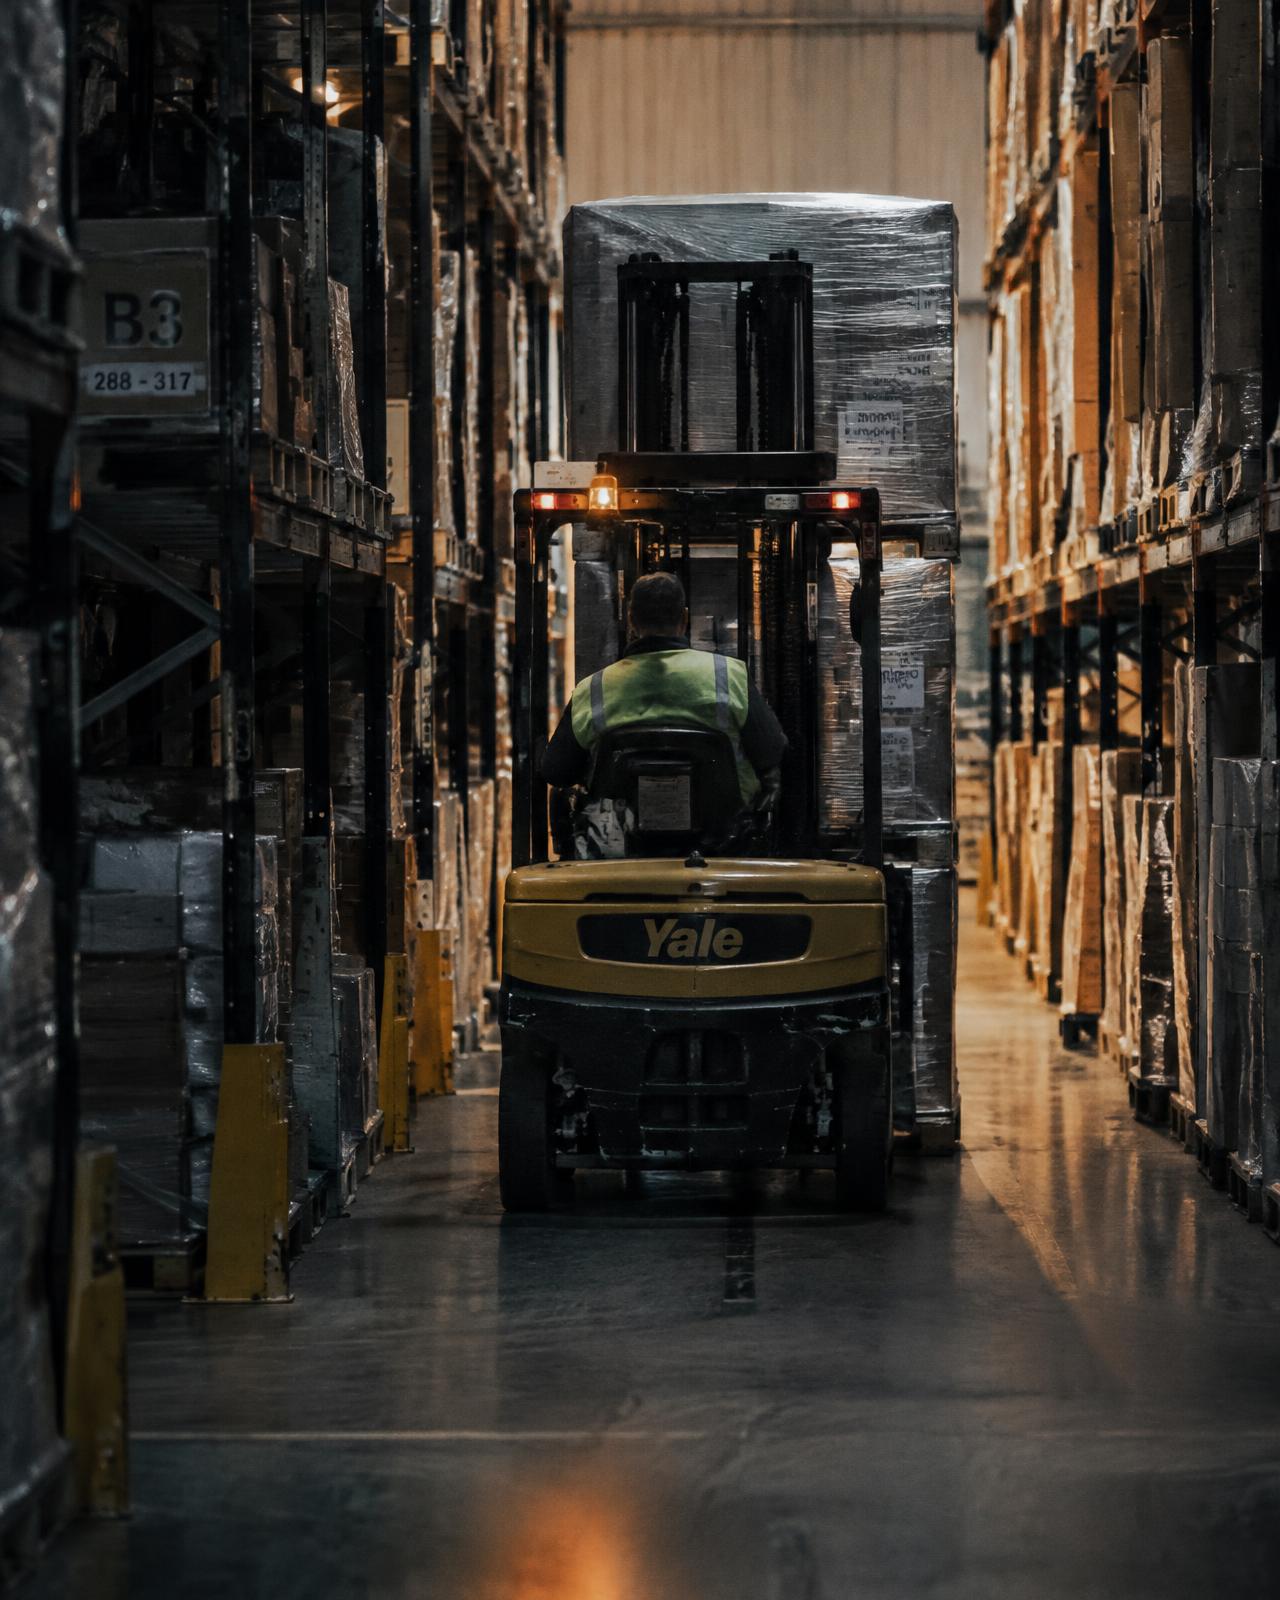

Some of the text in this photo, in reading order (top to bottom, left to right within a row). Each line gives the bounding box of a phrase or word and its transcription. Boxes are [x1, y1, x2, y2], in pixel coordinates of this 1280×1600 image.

[105, 291, 183, 347] B3
[94, 372, 132, 391] 288
[154, 372, 192, 391] 317
[643, 919, 743, 959] Yale
